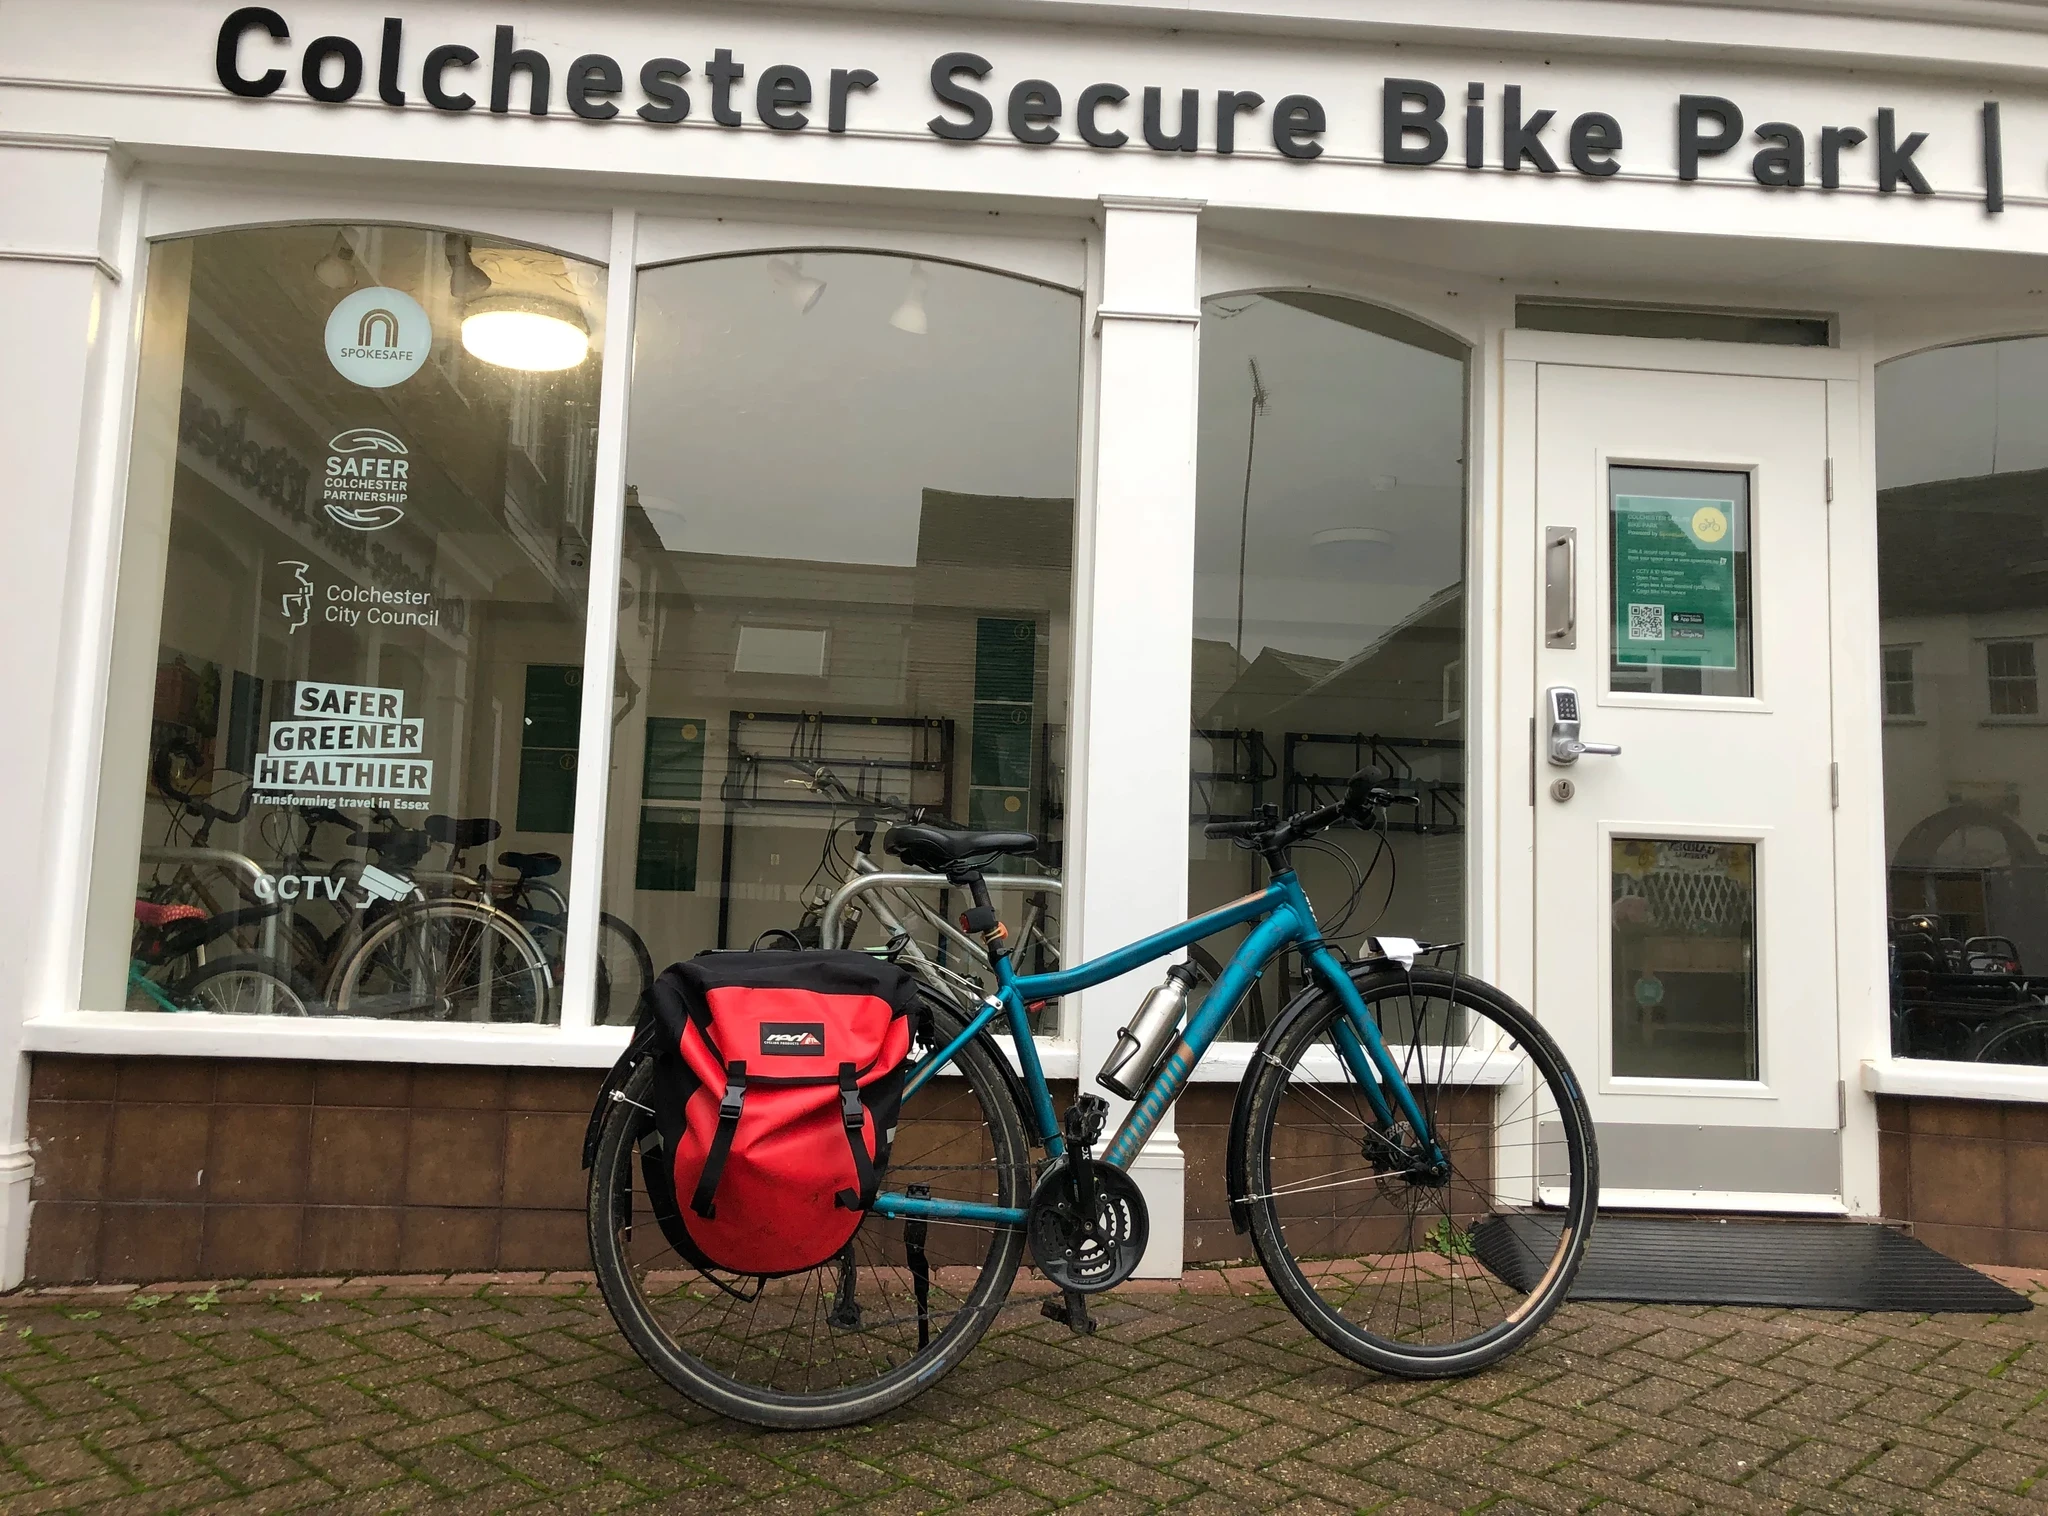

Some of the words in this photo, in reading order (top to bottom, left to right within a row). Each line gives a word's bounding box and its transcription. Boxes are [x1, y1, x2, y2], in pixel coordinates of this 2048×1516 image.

[215, 6, 879, 133] Colchester
[928, 52, 1327, 159] Secure
[1382, 78, 1623, 176] Bike
[1679, 95, 1936, 195] Park
[340, 347, 413, 361] SPOKESAFE
[325, 456, 409, 479] SAFER
[324, 477, 407, 492] COLCHESTER
[323, 490, 408, 503] PARTNERSHIP
[326, 584, 431, 606] Colchester
[325, 605, 358, 627] City
[367, 606, 440, 627] Council
[299, 686, 399, 719] SAFER
[273, 722, 419, 752] GREENER
[259, 758, 429, 790] HEALTHIER
[251, 793, 336, 809] Transforming
[339, 796, 376, 809] travel
[378, 798, 390, 809] in
[394, 798, 430, 811] Essex
[253, 873, 347, 902] CCTV
